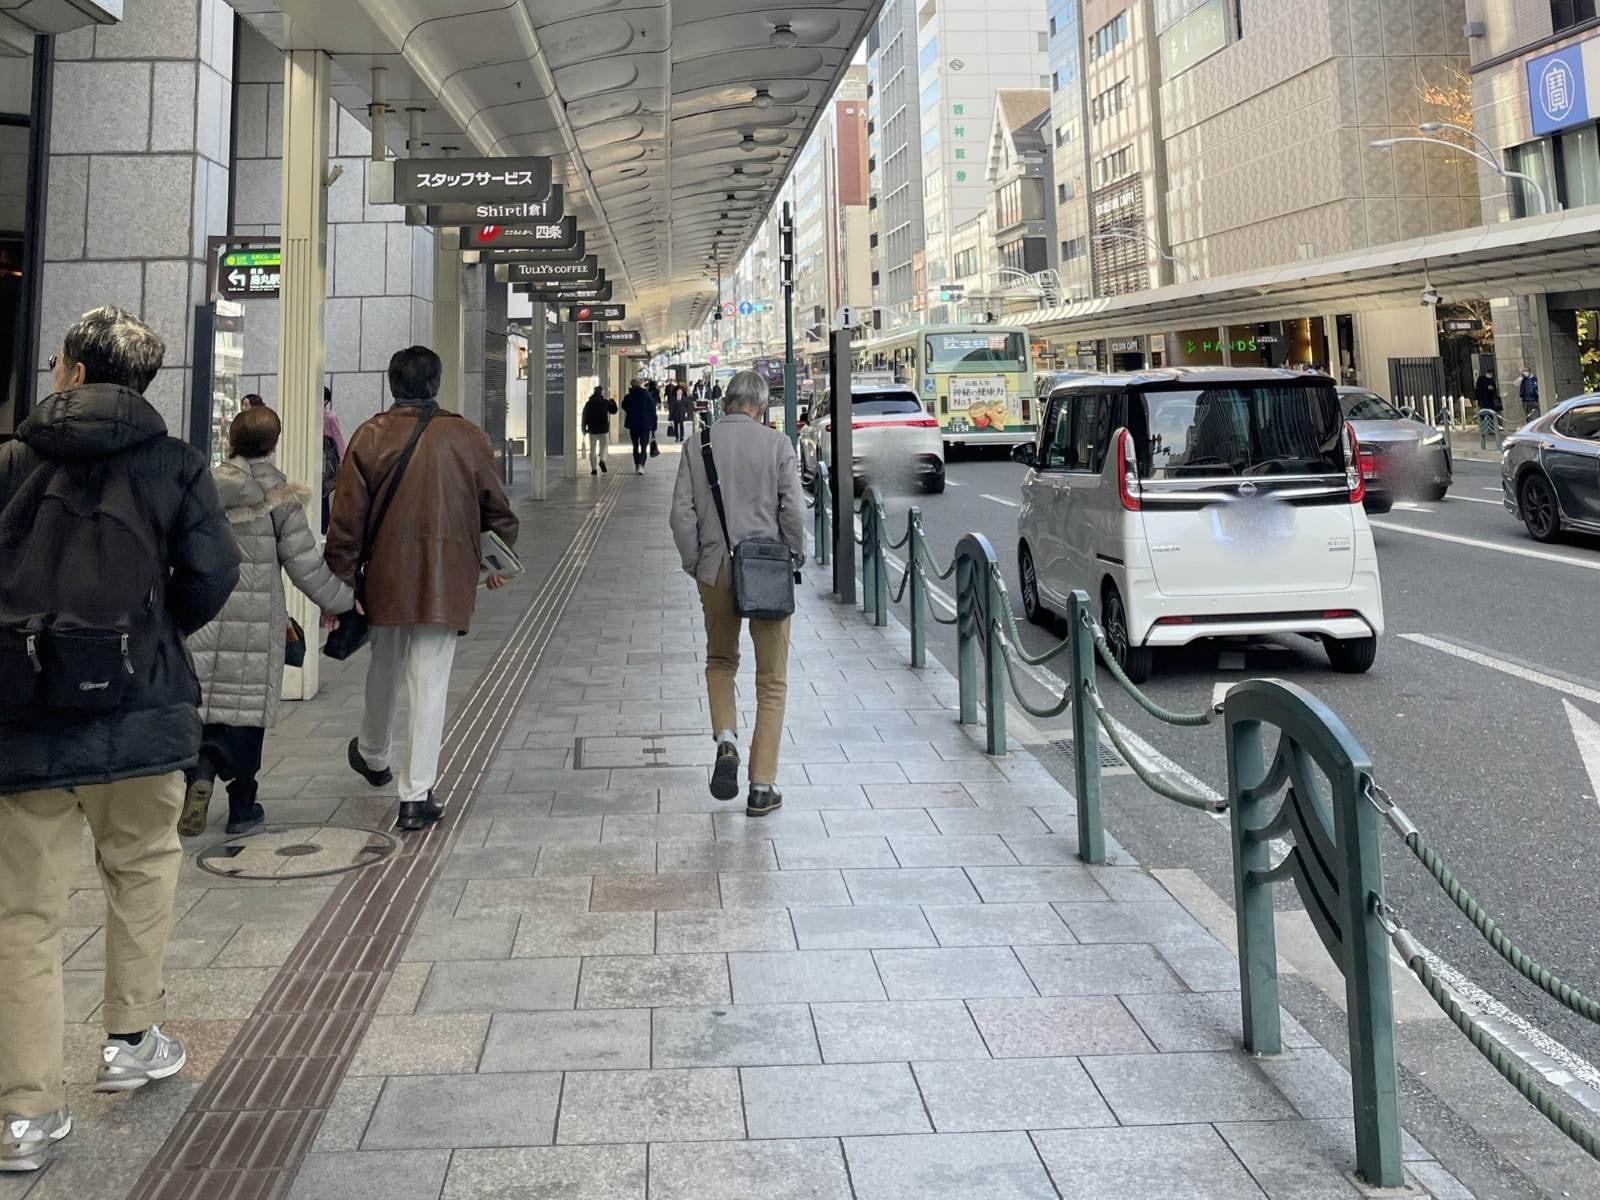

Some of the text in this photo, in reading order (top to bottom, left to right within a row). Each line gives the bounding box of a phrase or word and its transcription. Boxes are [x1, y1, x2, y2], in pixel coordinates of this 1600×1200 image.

[417, 171, 532, 188] スタッフサービス
[476, 205, 522, 218] Shirt
[535, 225, 562, 239] 四条
[554, 265, 589, 274] COFFEE
